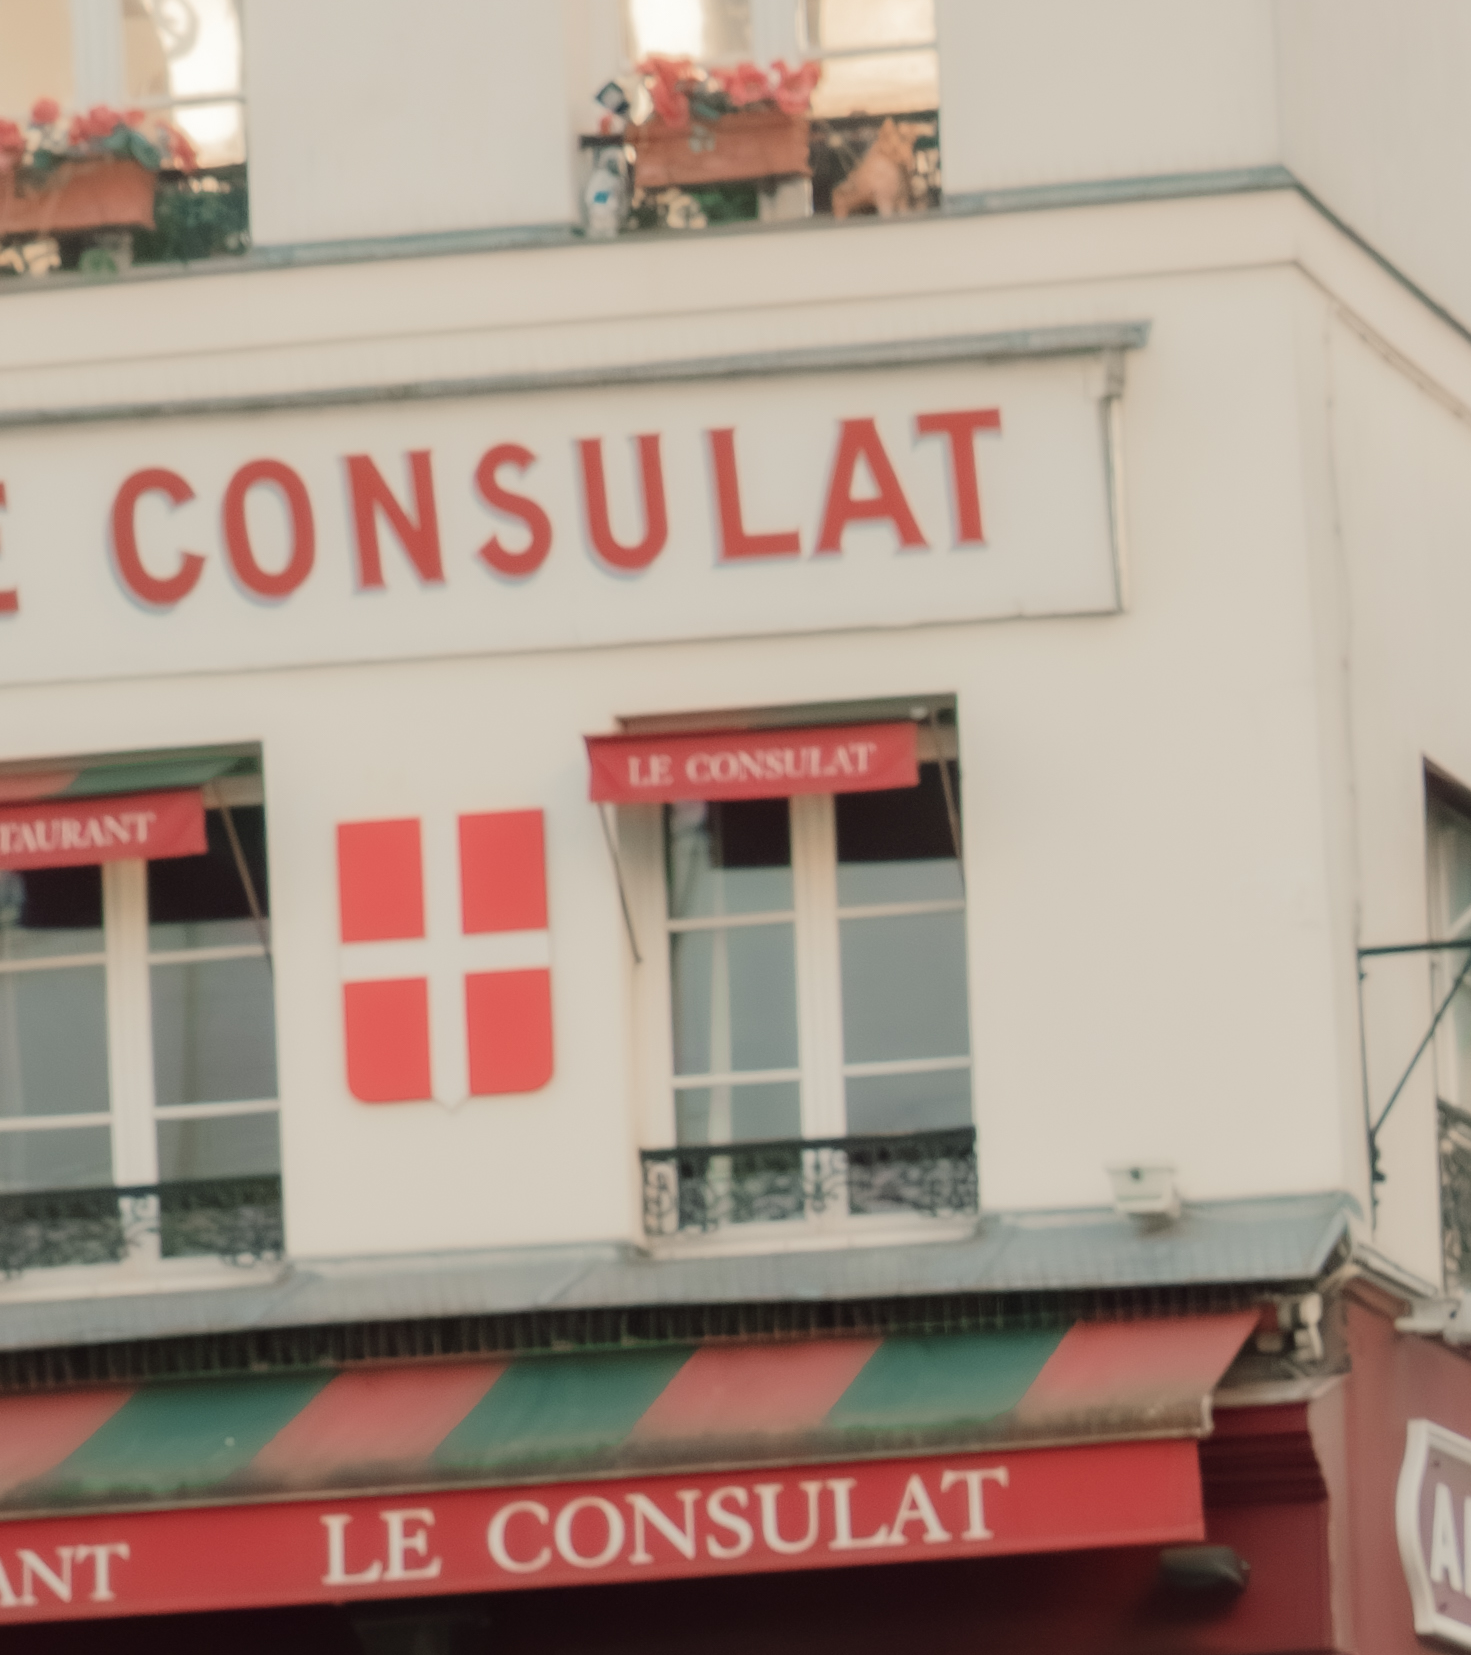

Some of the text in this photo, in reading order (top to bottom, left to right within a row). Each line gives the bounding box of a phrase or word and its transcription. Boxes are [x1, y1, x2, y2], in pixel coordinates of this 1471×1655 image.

[107, 405, 1004, 611] CONSULAT
[627, 742, 877, 787] LE CONSULAT
[320, 1466, 1010, 1587] LE CONSULAT
